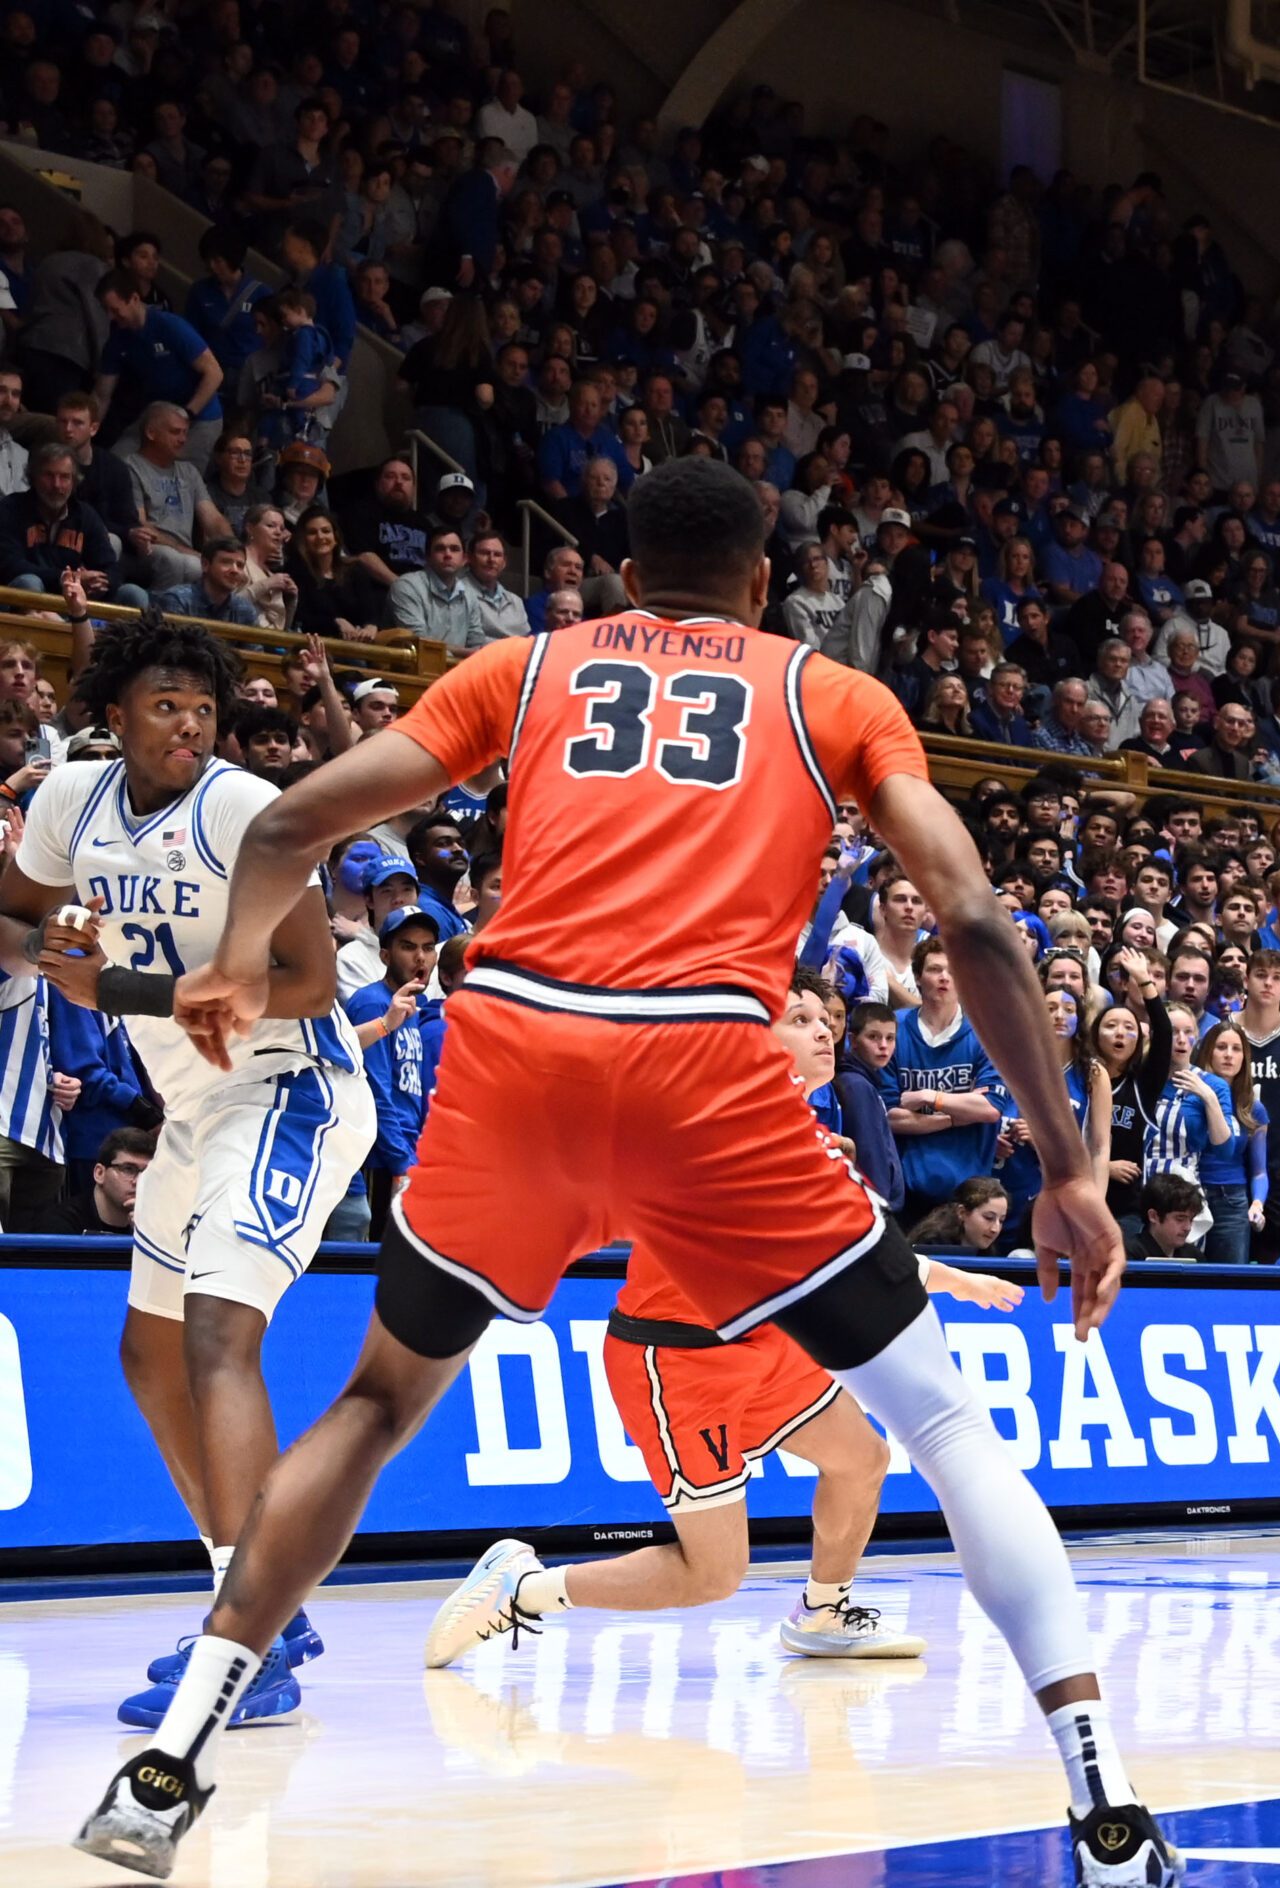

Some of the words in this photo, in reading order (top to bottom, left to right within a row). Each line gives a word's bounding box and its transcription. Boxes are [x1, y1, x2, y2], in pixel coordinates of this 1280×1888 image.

[592, 623, 746, 663] ONYENSO
[562, 658, 754, 791] 33
[381, 857, 406, 867] DUKE
[89, 874, 200, 918] DUKE
[121, 922, 186, 978] 21
[899, 1063, 974, 1094] DUKE
[1112, 1104, 1136, 1129] KE
[266, 1168, 302, 1207] D
[699, 1424, 730, 1472] V
[1186, 1505, 1231, 1514] DAKTRONICS
[593, 1529, 653, 1540] DAKTRONICS
[137, 1766, 185, 1798] GiGi
